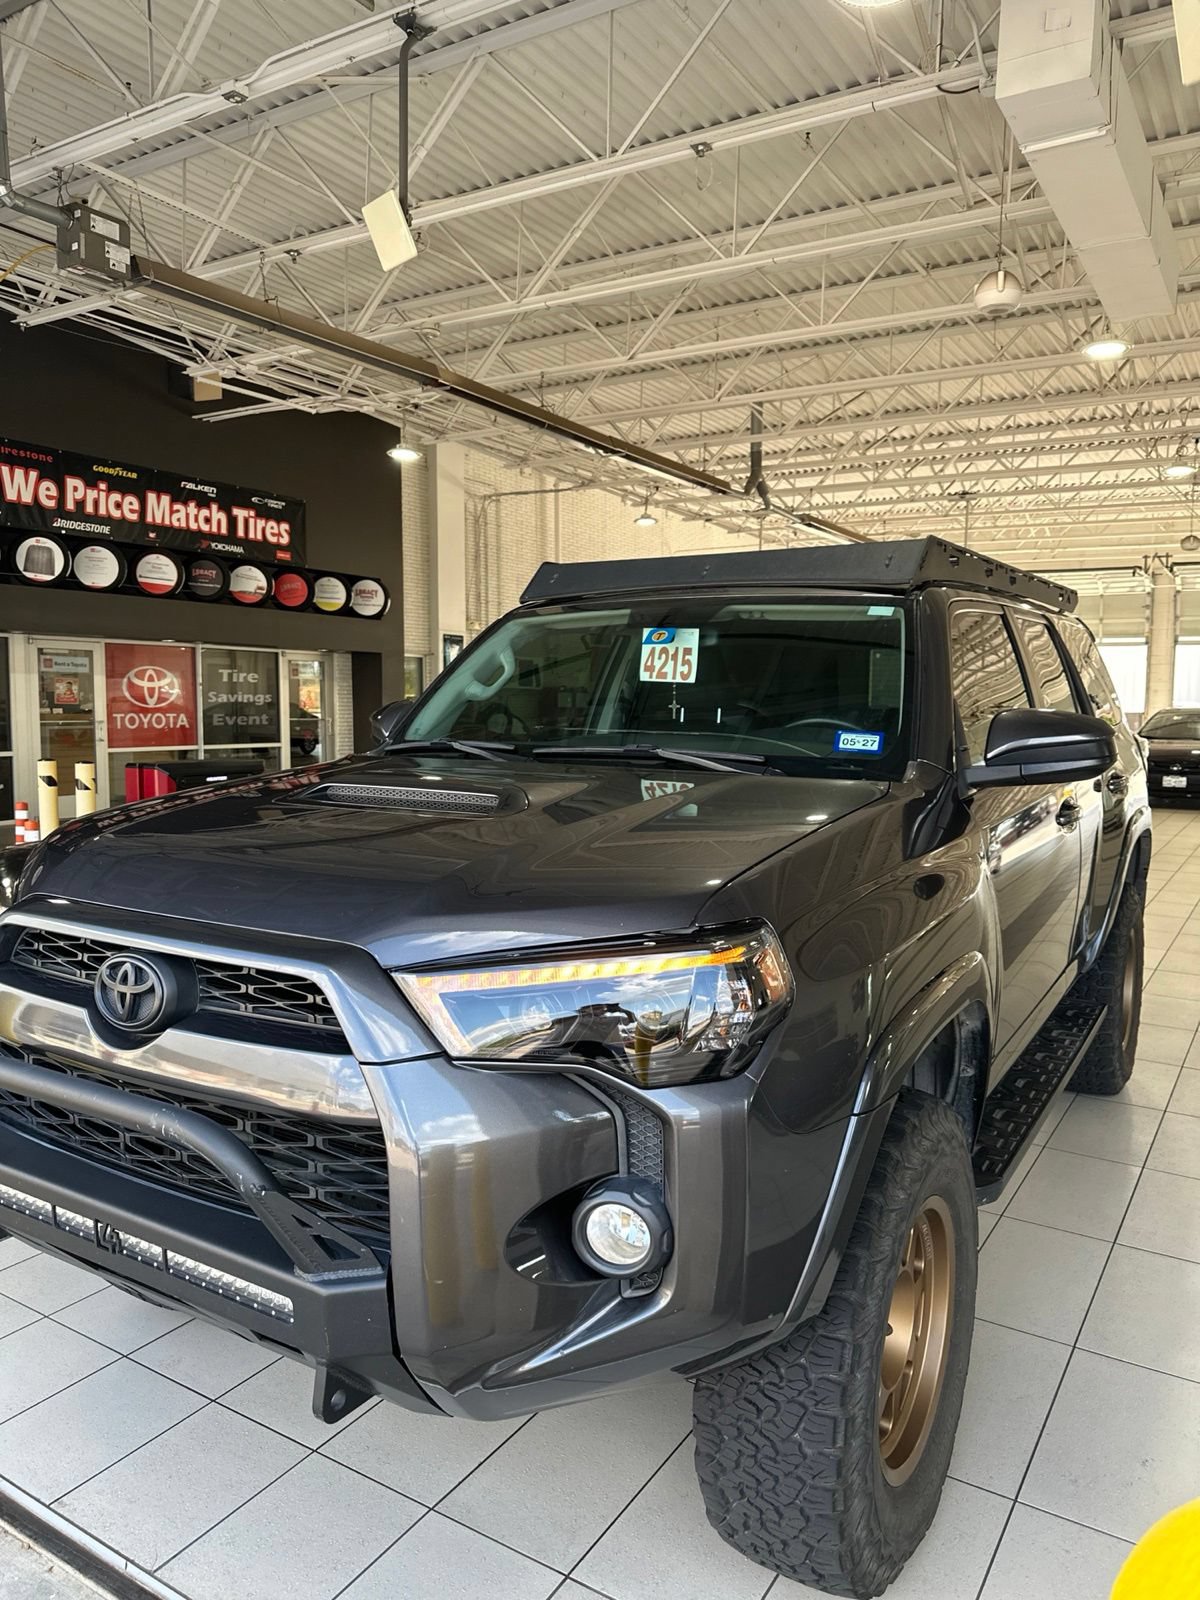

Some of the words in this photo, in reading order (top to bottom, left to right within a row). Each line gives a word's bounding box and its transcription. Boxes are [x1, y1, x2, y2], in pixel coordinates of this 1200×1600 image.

[0, 445, 53, 463] irestone
[180, 481, 217, 494] FALKEN
[0, 462, 59, 510] We
[64, 475, 140, 522] Price
[145, 489, 228, 537] Match
[231, 505, 291, 547] Tires
[52, 518, 112, 535] BRIDGESTONE
[210, 541, 245, 554] YOKOHAMA
[643, 646, 693, 681] 4215
[218, 668, 259, 683] Tire
[207, 690, 273, 706] Savings
[112, 713, 190, 729] TOYOTA
[212, 713, 269, 726] Event
